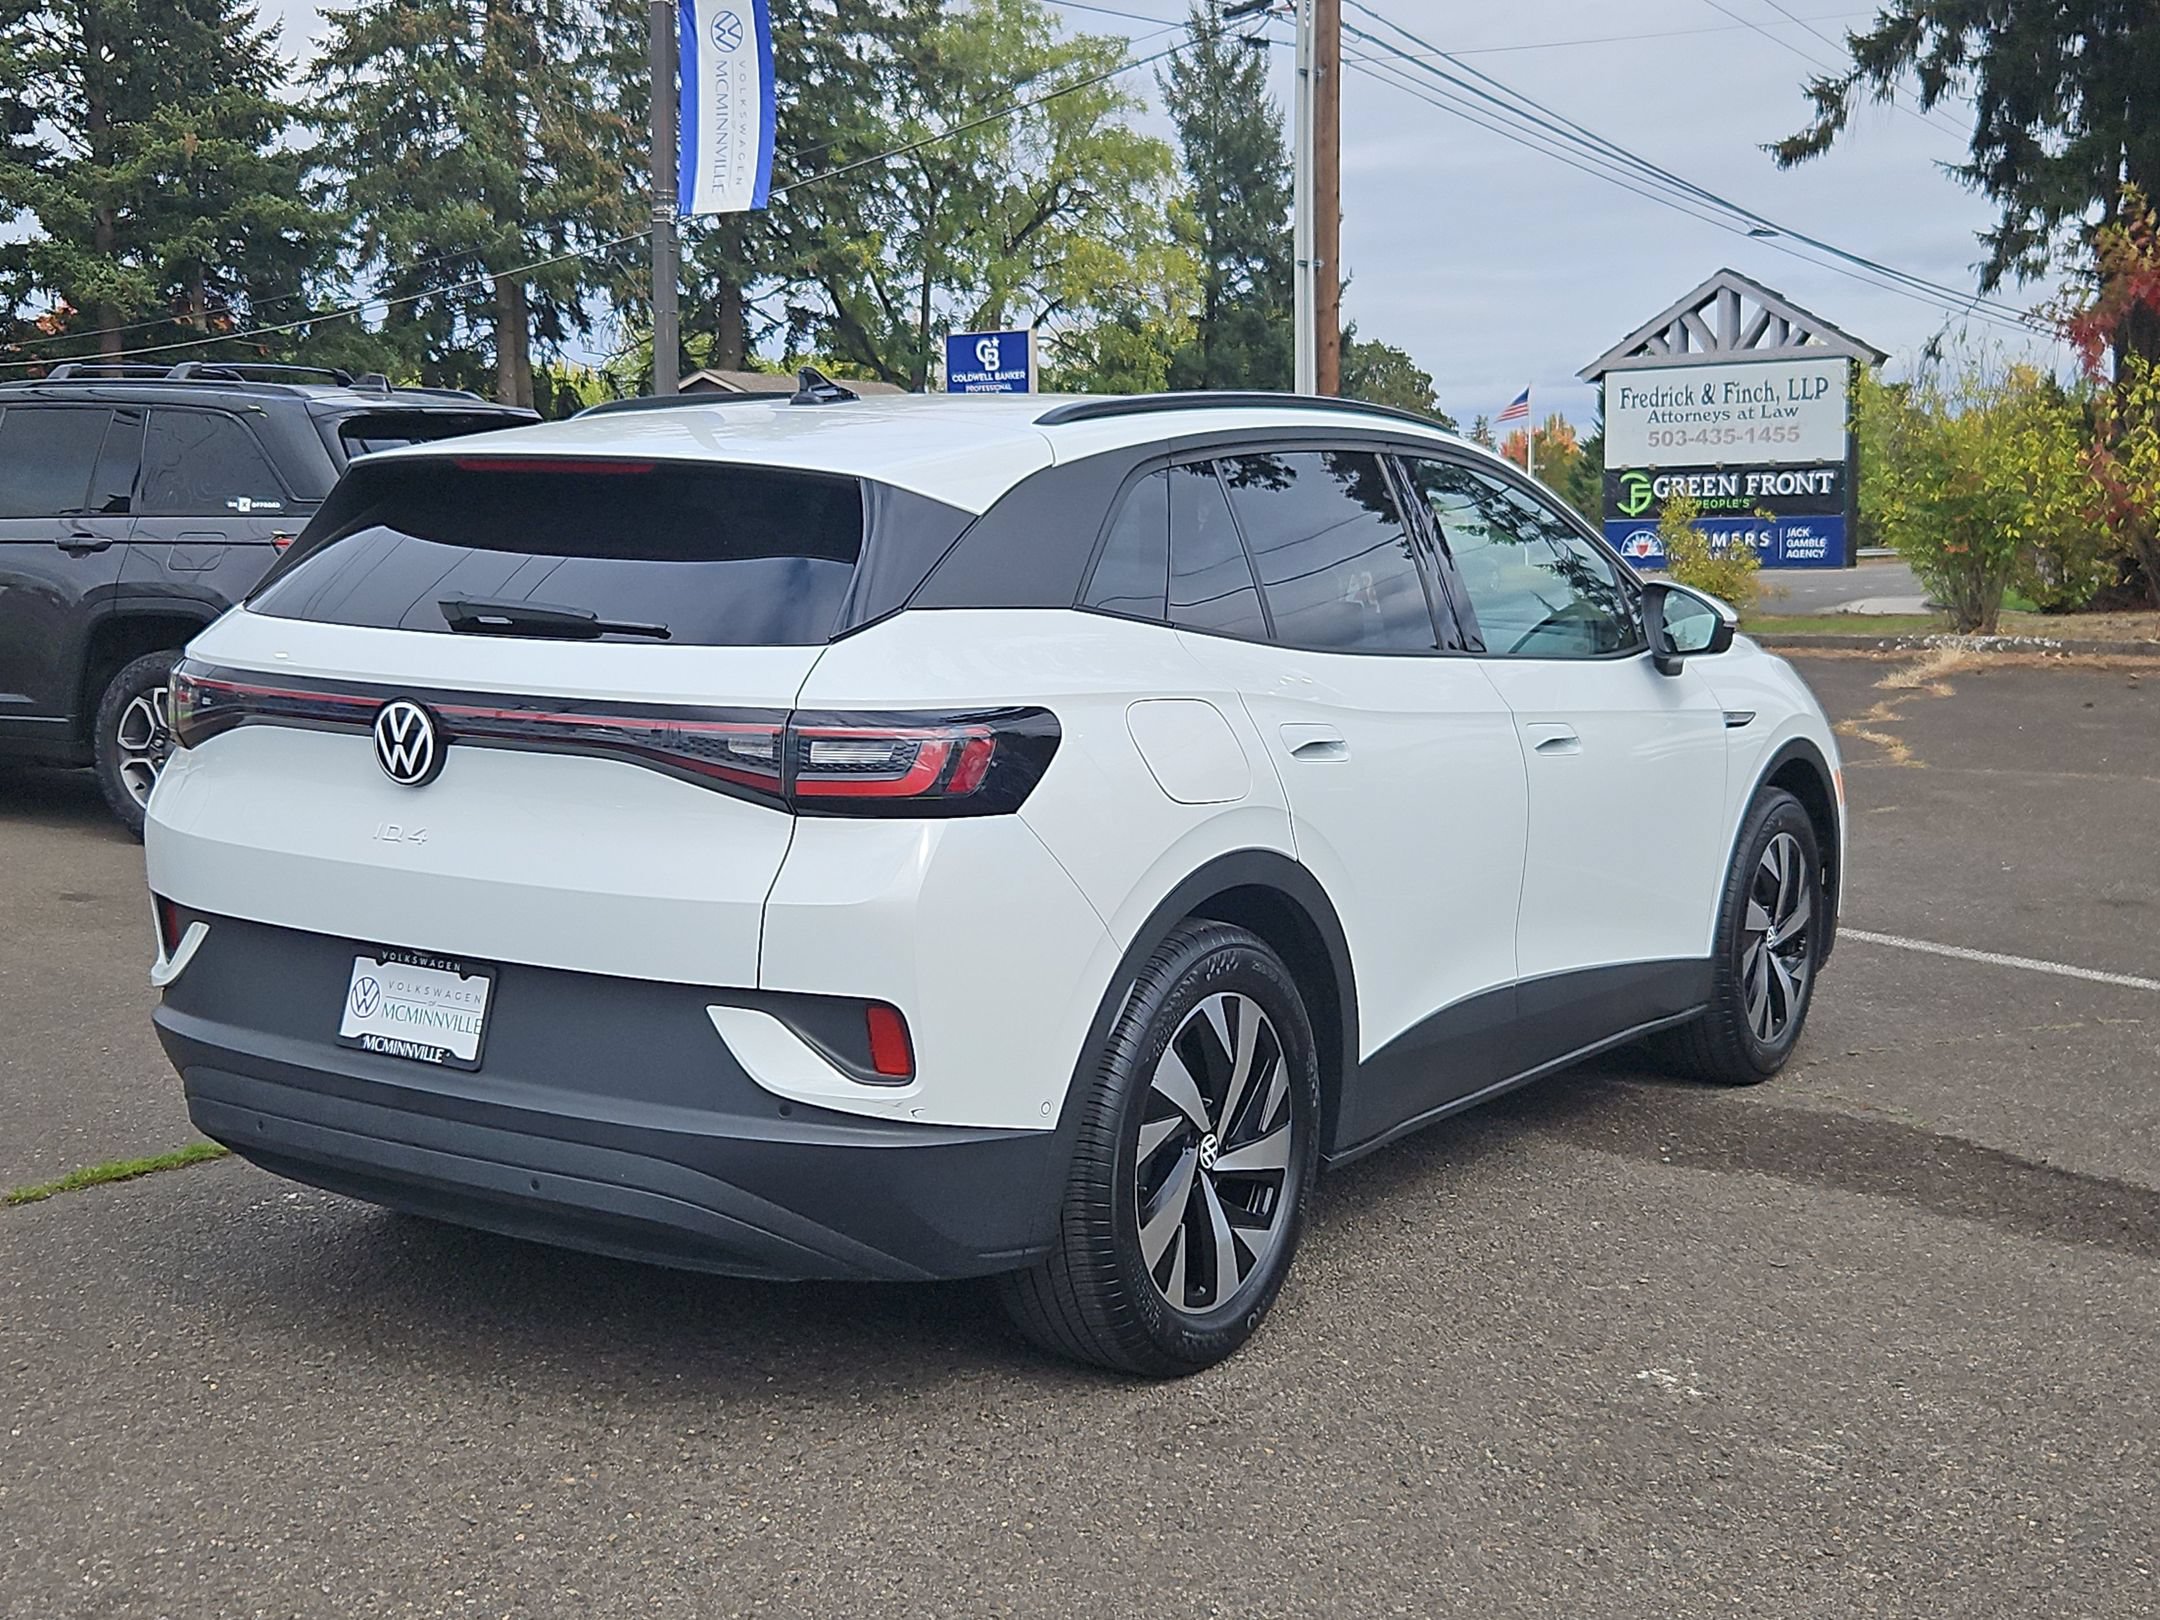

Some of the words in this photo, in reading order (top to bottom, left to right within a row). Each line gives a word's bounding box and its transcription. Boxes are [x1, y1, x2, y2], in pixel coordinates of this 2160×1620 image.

[711, 60, 729, 195] MCMINNVILLE
[736, 61, 748, 186] VOLKSWAGEN
[952, 372, 994, 383] COLDWELL
[994, 371, 1026, 381] BANKER
[965, 384, 1012, 393] PROFESSIONAL
[1619, 383, 1695, 410] Fredrick
[1701, 382, 1716, 406] &
[1723, 379, 1780, 405] Finch,
[1788, 377, 1829, 401] LLP
[1647, 408, 1731, 424] Attorneys
[1737, 407, 1755, 420] at
[1761, 405, 1799, 418] Law
[1648, 426, 1800, 448] 503-435-1455
[1653, 473, 1738, 499] GREEN
[1745, 470, 1836, 496] FRONT
[1786, 526, 1810, 538] JACK
[1786, 538, 1826, 549] GAMBLE
[1786, 549, 1826, 559] AGENCY
[381, 950, 462, 972] VOLKSWAGEN
[388, 980, 482, 1005] VOLKSWAGEN
[381, 1002, 483, 1036] MCMINNVILLE
[363, 1035, 445, 1064] MCMINNVILLE
